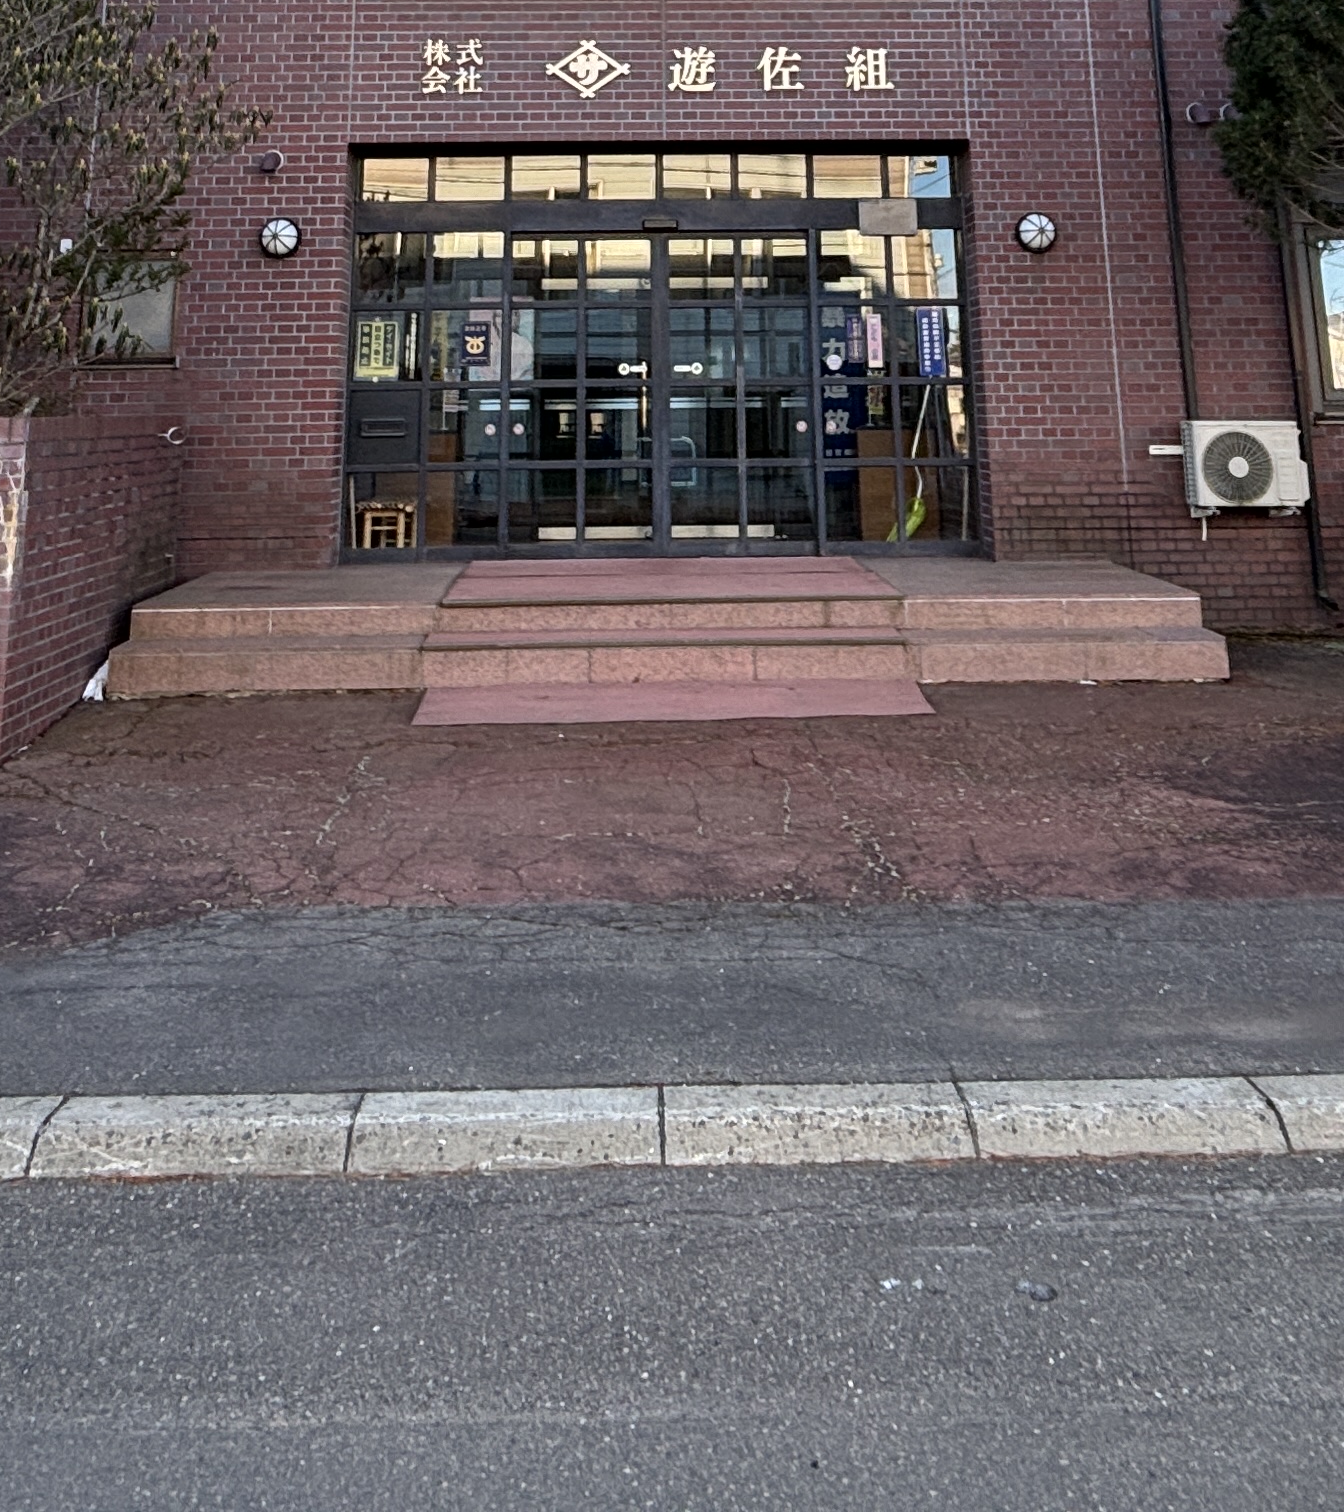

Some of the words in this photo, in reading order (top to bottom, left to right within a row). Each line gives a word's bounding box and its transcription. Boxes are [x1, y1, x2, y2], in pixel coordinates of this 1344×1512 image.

[422, 39, 484, 66] 株式
[420, 67, 484, 95] 会社
[668, 46, 895, 92] 遊佐組
